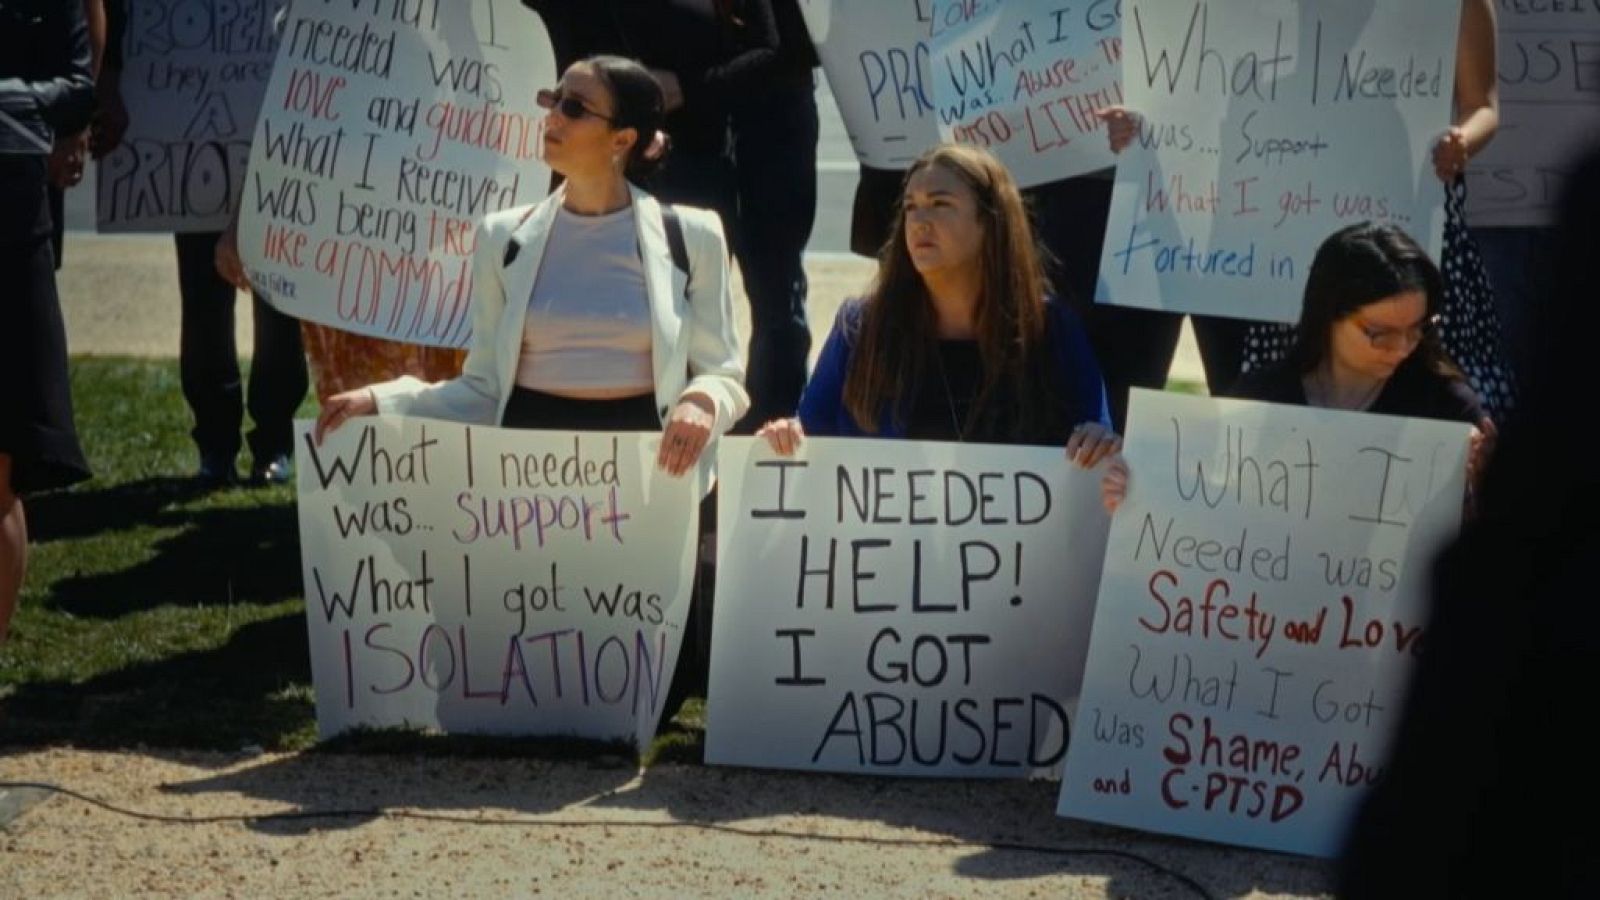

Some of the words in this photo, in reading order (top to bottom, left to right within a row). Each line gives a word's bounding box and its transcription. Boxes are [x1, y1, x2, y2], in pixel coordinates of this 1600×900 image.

[288, 18, 396, 80] needed
[945, 20, 1035, 97] What
[1046, 7, 1071, 45] I
[1133, 0, 1294, 101] What
[1311, 19, 1323, 105] I
[1334, 48, 1443, 100] Needed
[183, 91, 237, 139] A
[284, 69, 347, 121] love
[367, 96, 420, 137] and
[264, 119, 346, 180] What
[354, 132, 382, 190] I
[336, 191, 417, 257] being
[1145, 170, 1222, 216] What
[1232, 176, 1260, 217] I
[1273, 181, 1323, 229] got
[263, 225, 308, 268] like
[315, 239, 338, 277] a
[1269, 252, 1294, 280] in
[305, 424, 439, 490] What
[464, 426, 475, 489] I
[499, 435, 621, 490] needed
[1171, 417, 1321, 520] What
[1347, 446, 1414, 528] I
[750, 460, 810, 520] I
[836, 464, 1053, 527] NEEDED
[795, 534, 1024, 613] HELP!
[1134, 512, 1292, 584] Needed
[1318, 553, 1398, 594] was
[313, 549, 435, 624] What
[463, 553, 472, 618] I
[503, 562, 567, 637] got
[1138, 569, 1276, 659] Safety
[1283, 606, 1328, 646] and
[342, 623, 667, 716] ISOLATION
[774, 628, 827, 687] I
[866, 626, 992, 688] GOT
[1128, 644, 1239, 711] What
[1254, 667, 1294, 720] I
[1312, 680, 1387, 727] Got
[811, 691, 1072, 769] ABUSED
[1162, 712, 1306, 782] Shame,
[1092, 770, 1132, 797] and
[1160, 768, 1305, 824] C-PTSD
